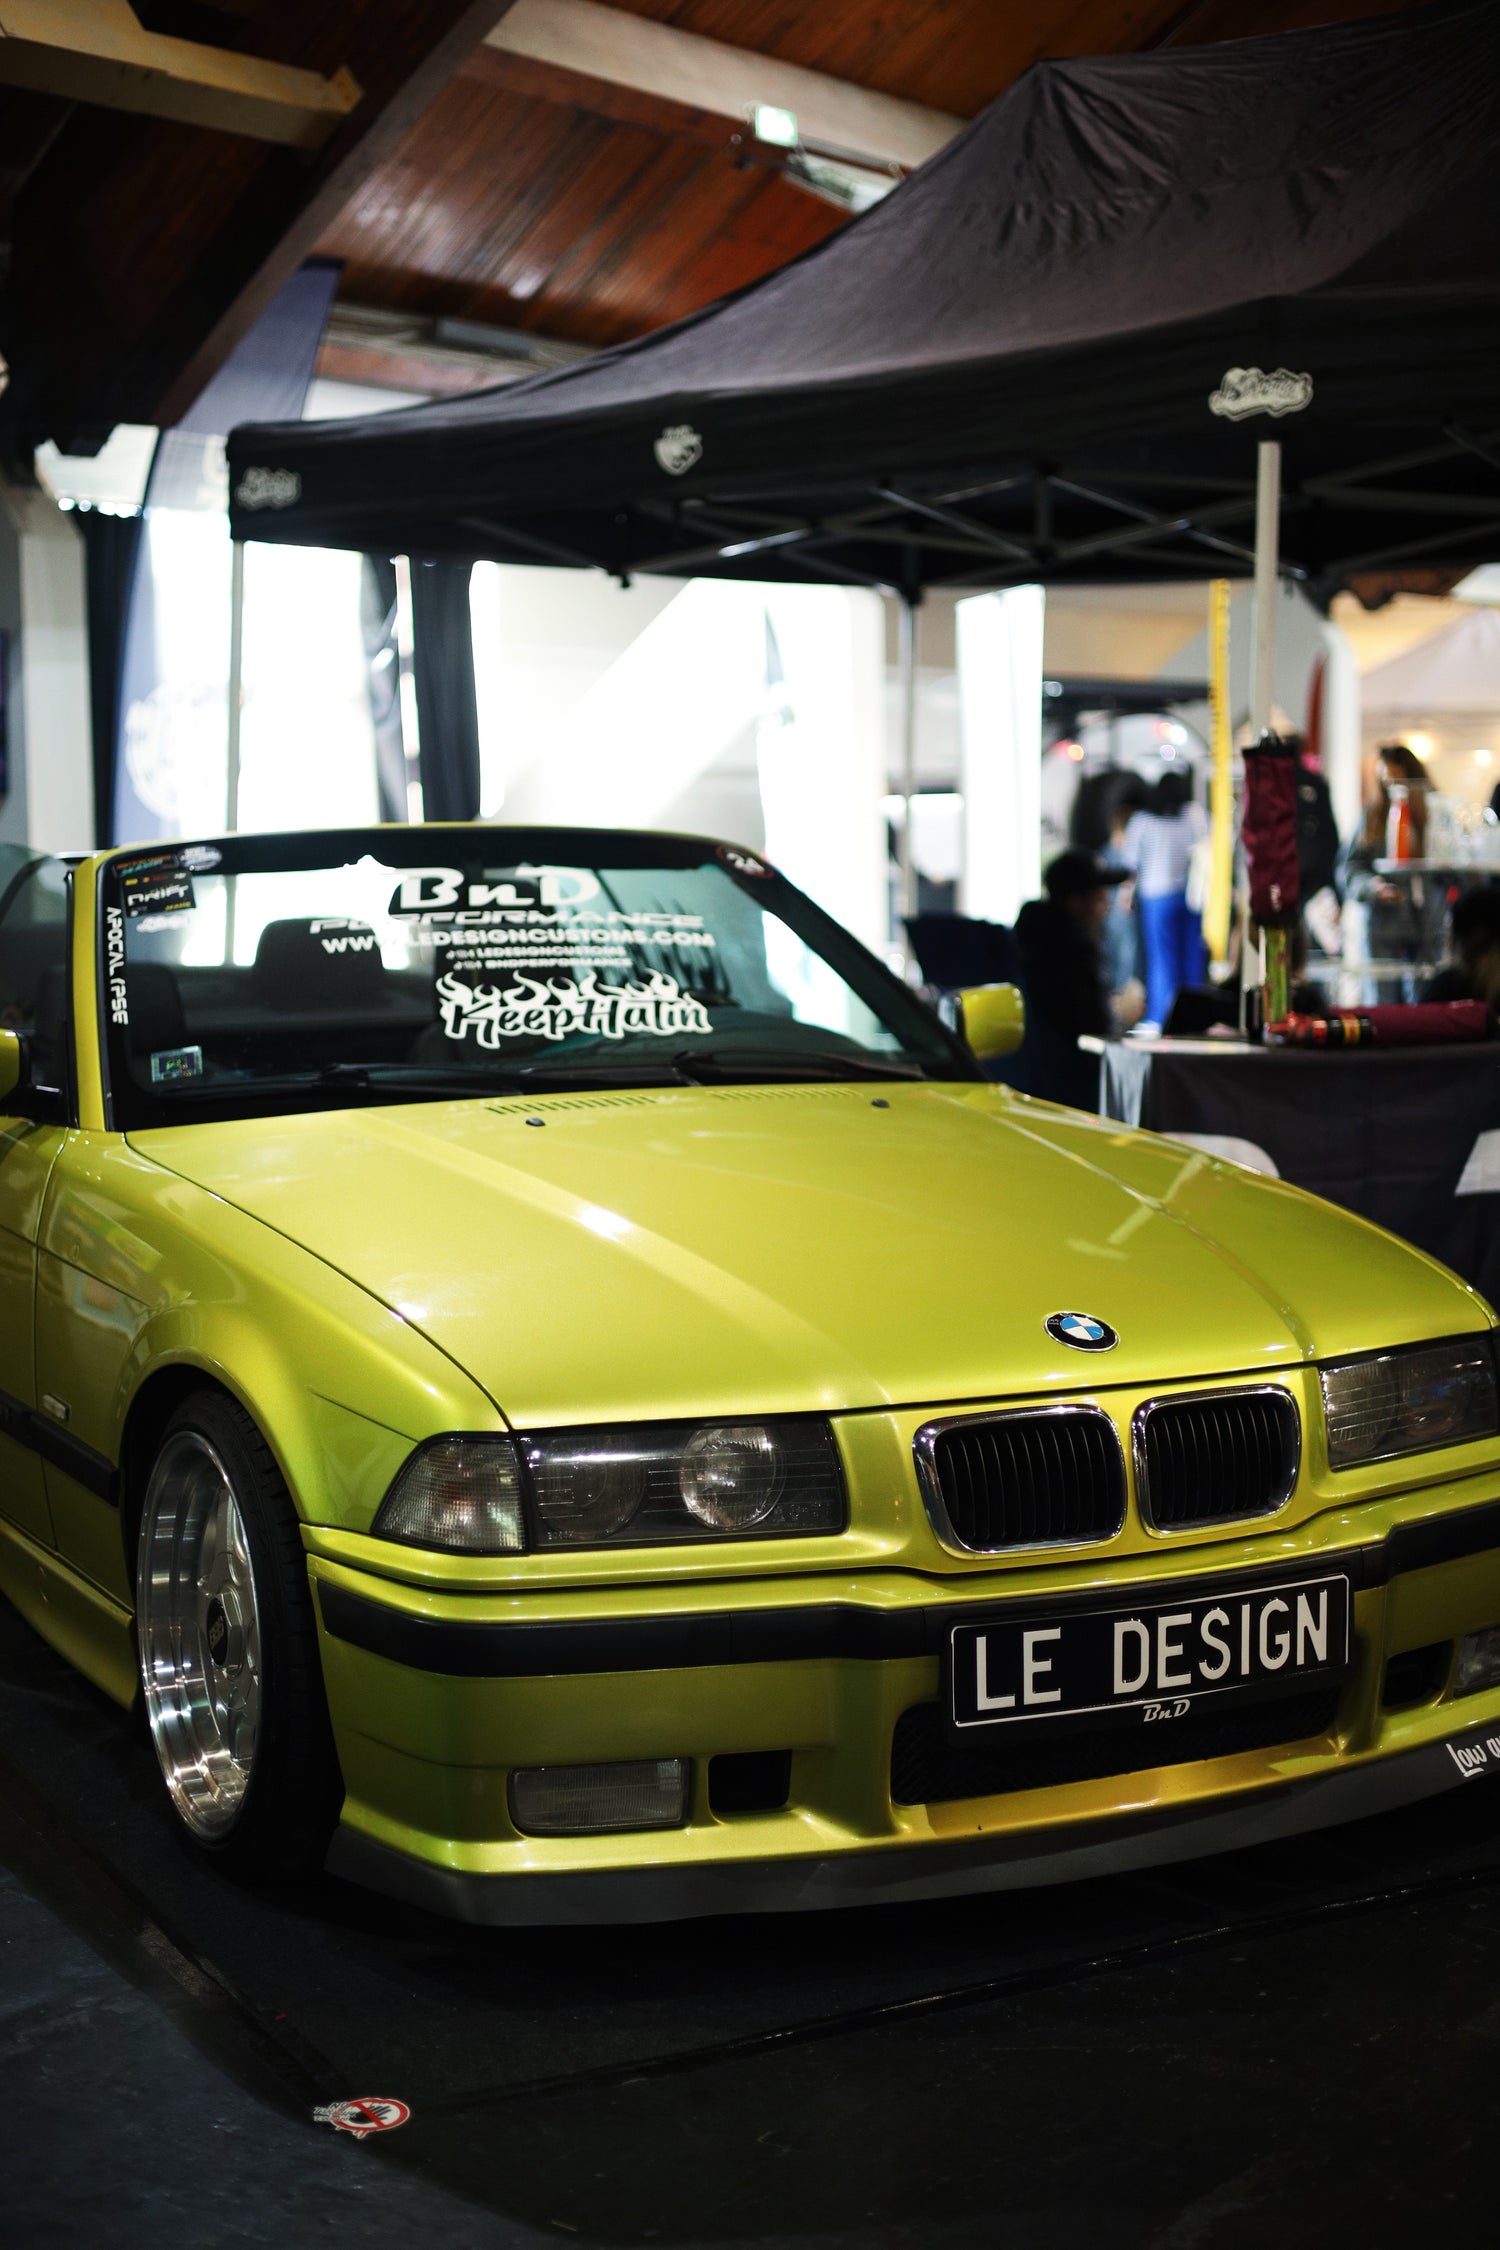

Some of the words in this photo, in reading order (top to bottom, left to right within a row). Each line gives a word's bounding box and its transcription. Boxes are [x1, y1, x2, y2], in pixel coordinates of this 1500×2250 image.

[396, 865, 601, 909] BnD
[976, 1626, 1062, 1712] LE
[1113, 1588, 1329, 1696] DESIGN
[1143, 1698, 1191, 1723] BnD
